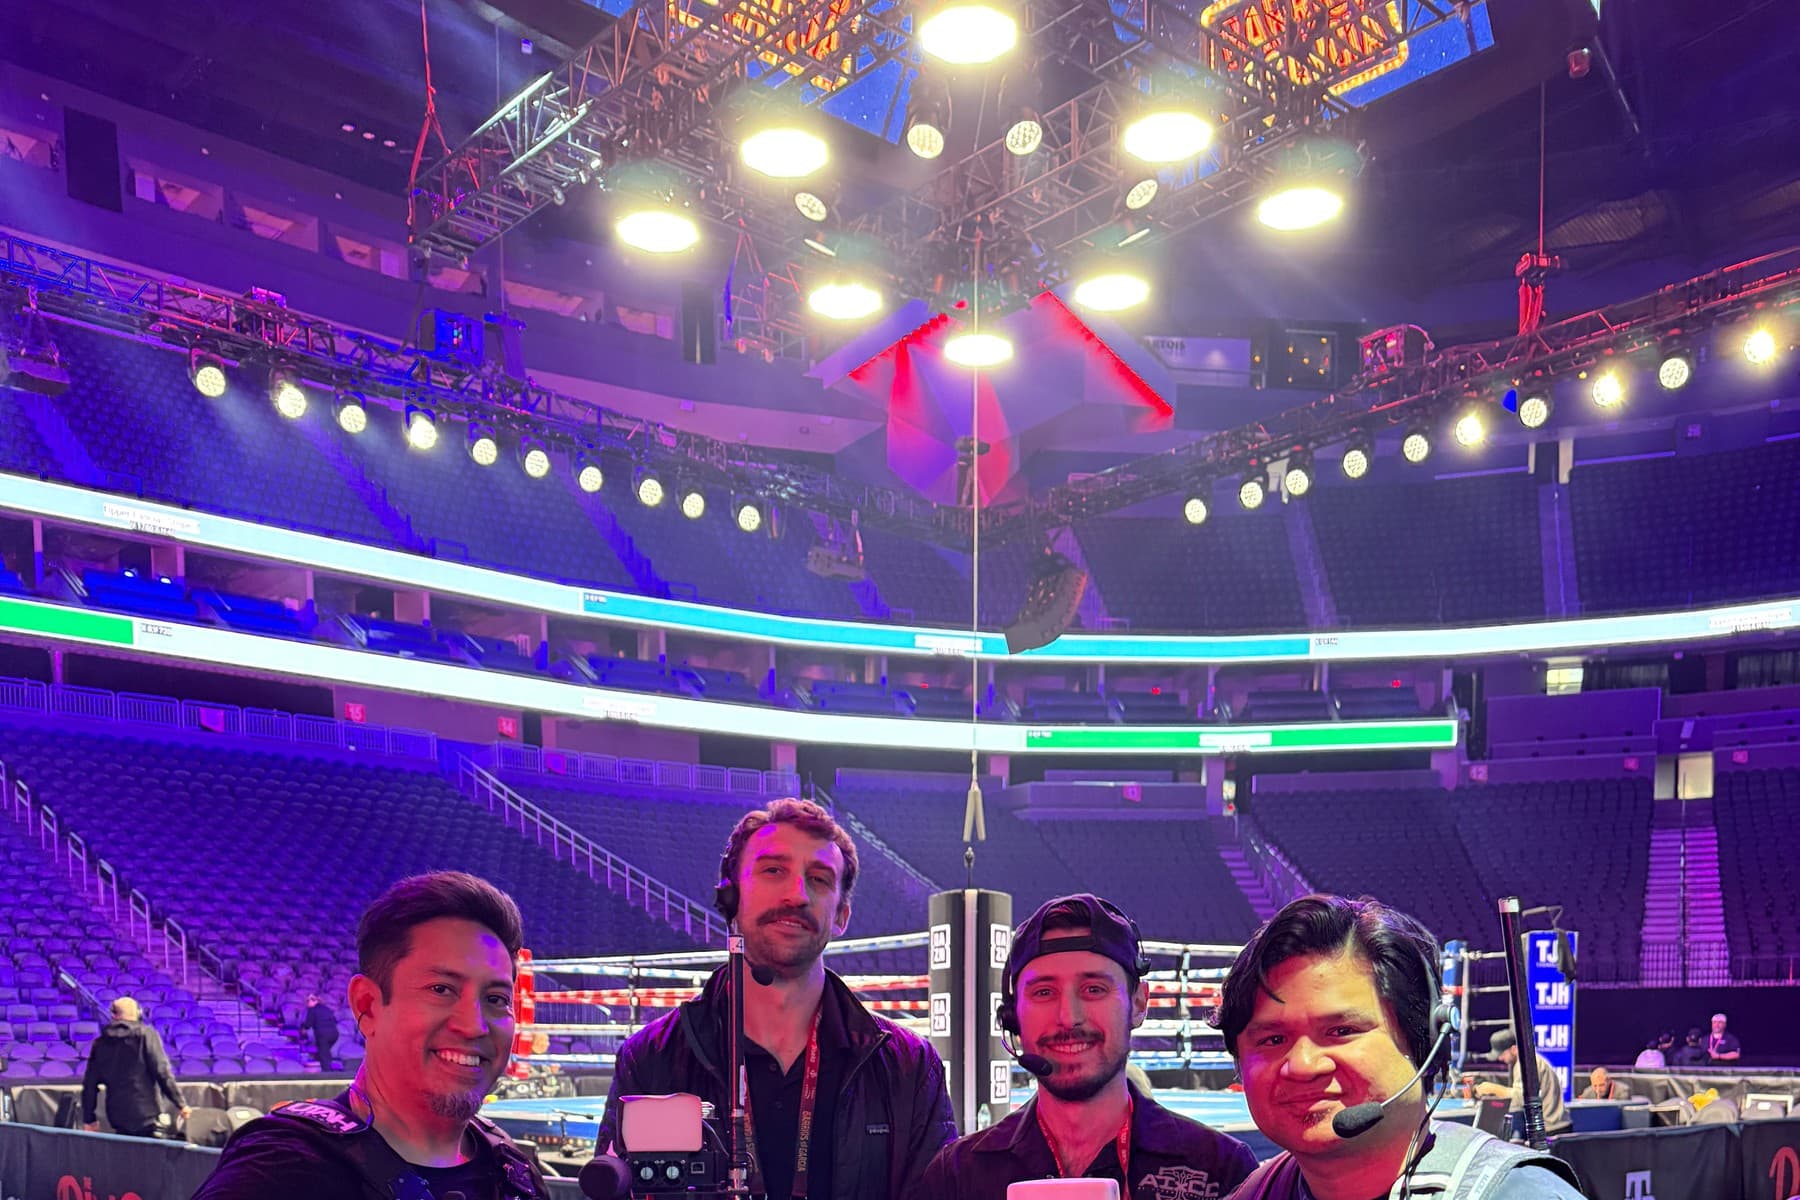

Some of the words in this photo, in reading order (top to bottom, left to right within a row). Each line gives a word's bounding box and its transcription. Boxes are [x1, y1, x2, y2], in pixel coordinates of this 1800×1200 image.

[1536, 940, 1560, 963] TJ
[1535, 982, 1570, 1006] TJH
[1534, 1025, 1570, 1048] TJH
[287, 1101, 358, 1132] UTAH
